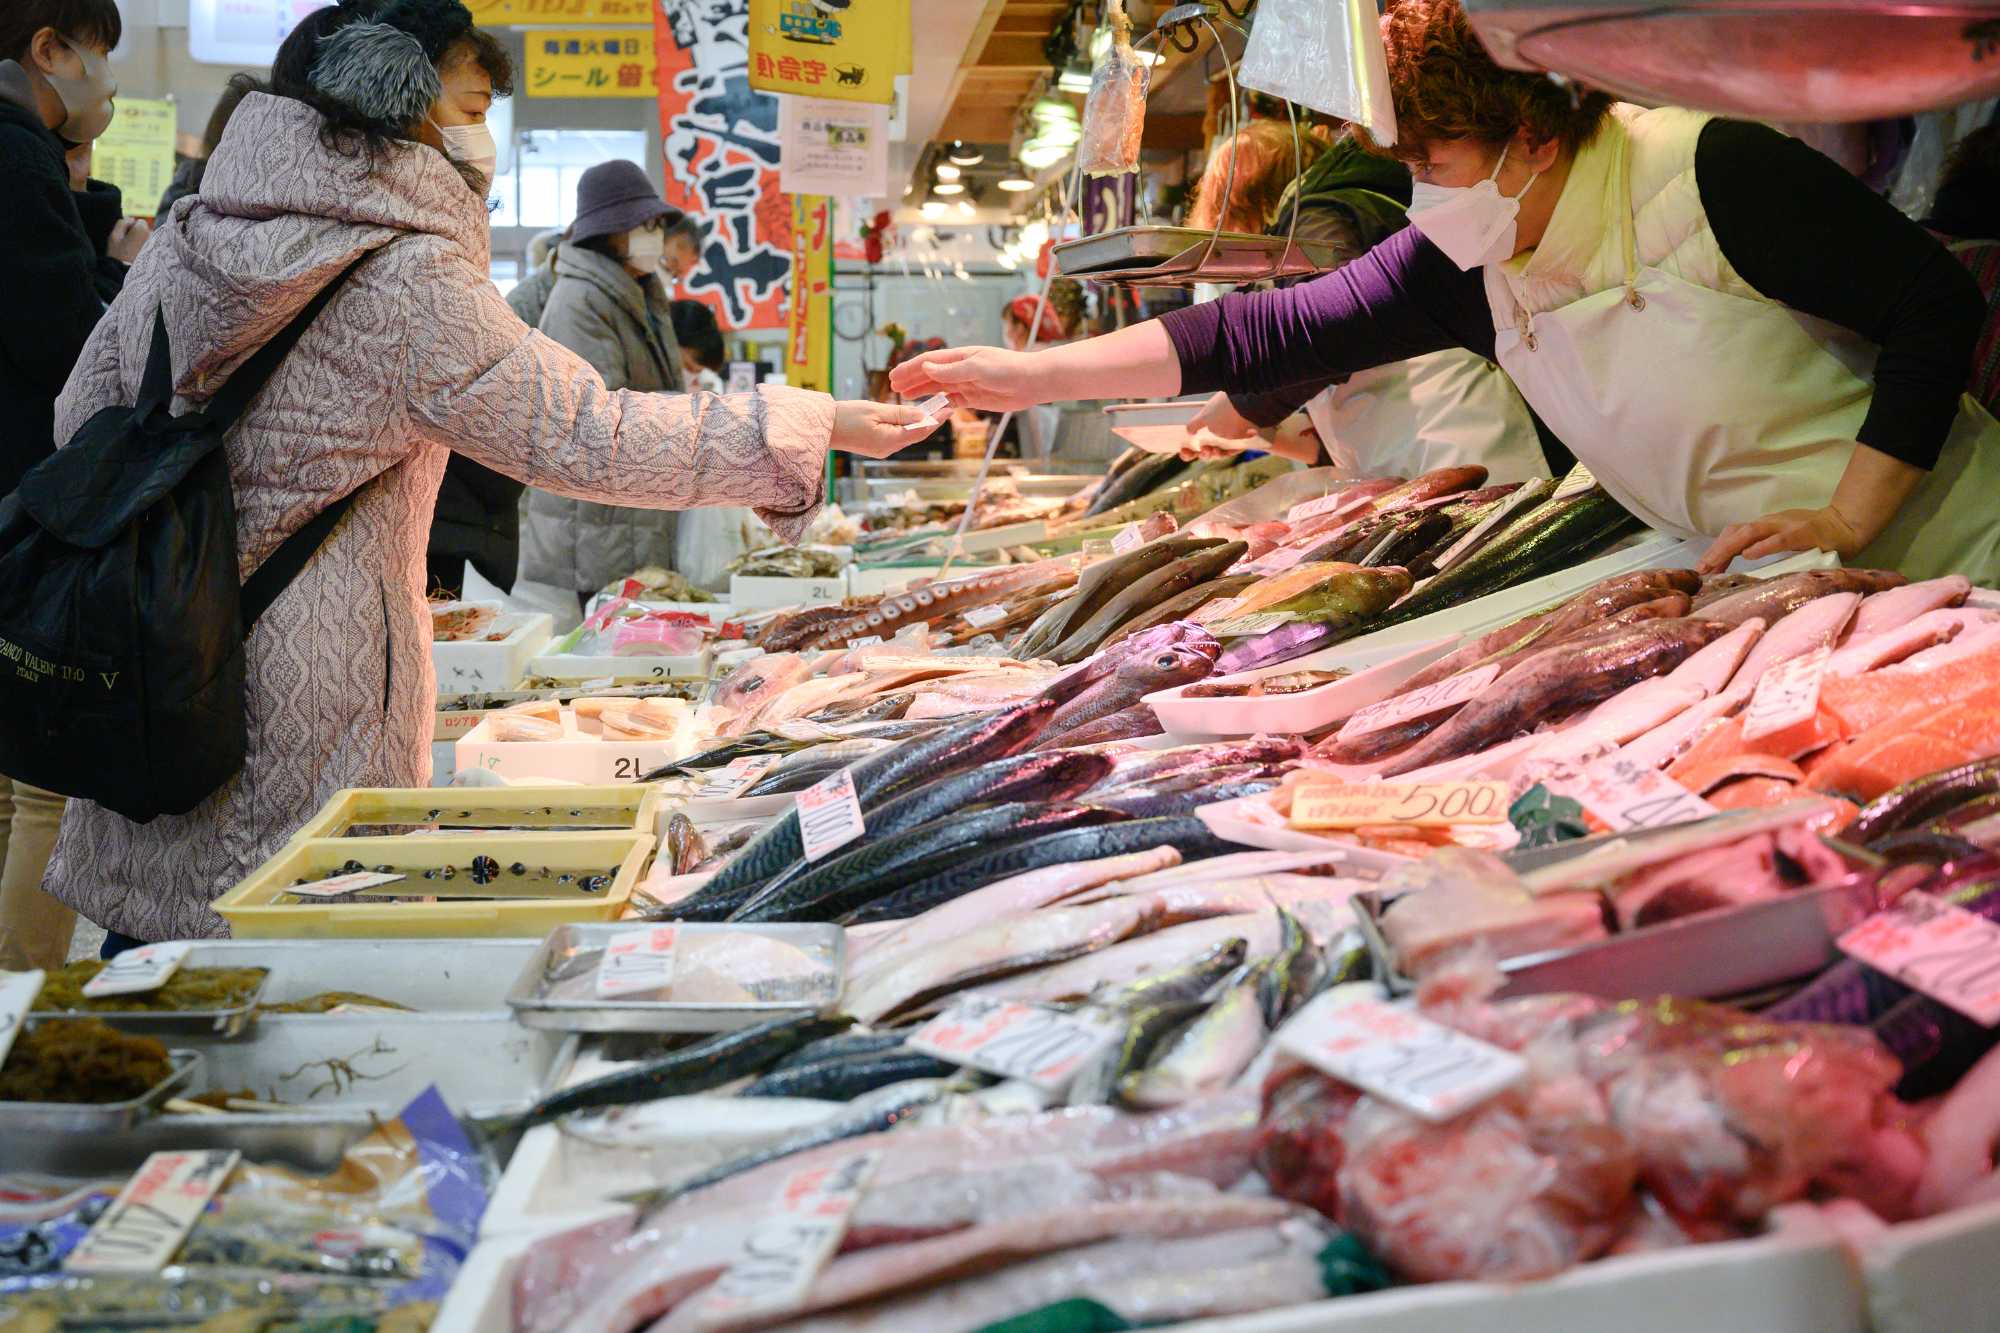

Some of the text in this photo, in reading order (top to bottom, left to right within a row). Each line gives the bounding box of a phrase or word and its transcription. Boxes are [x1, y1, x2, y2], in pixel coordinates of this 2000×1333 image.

[812, 586, 833, 599] 2L
[99, 671, 120, 690] V
[1391, 784, 1497, 822] 500
